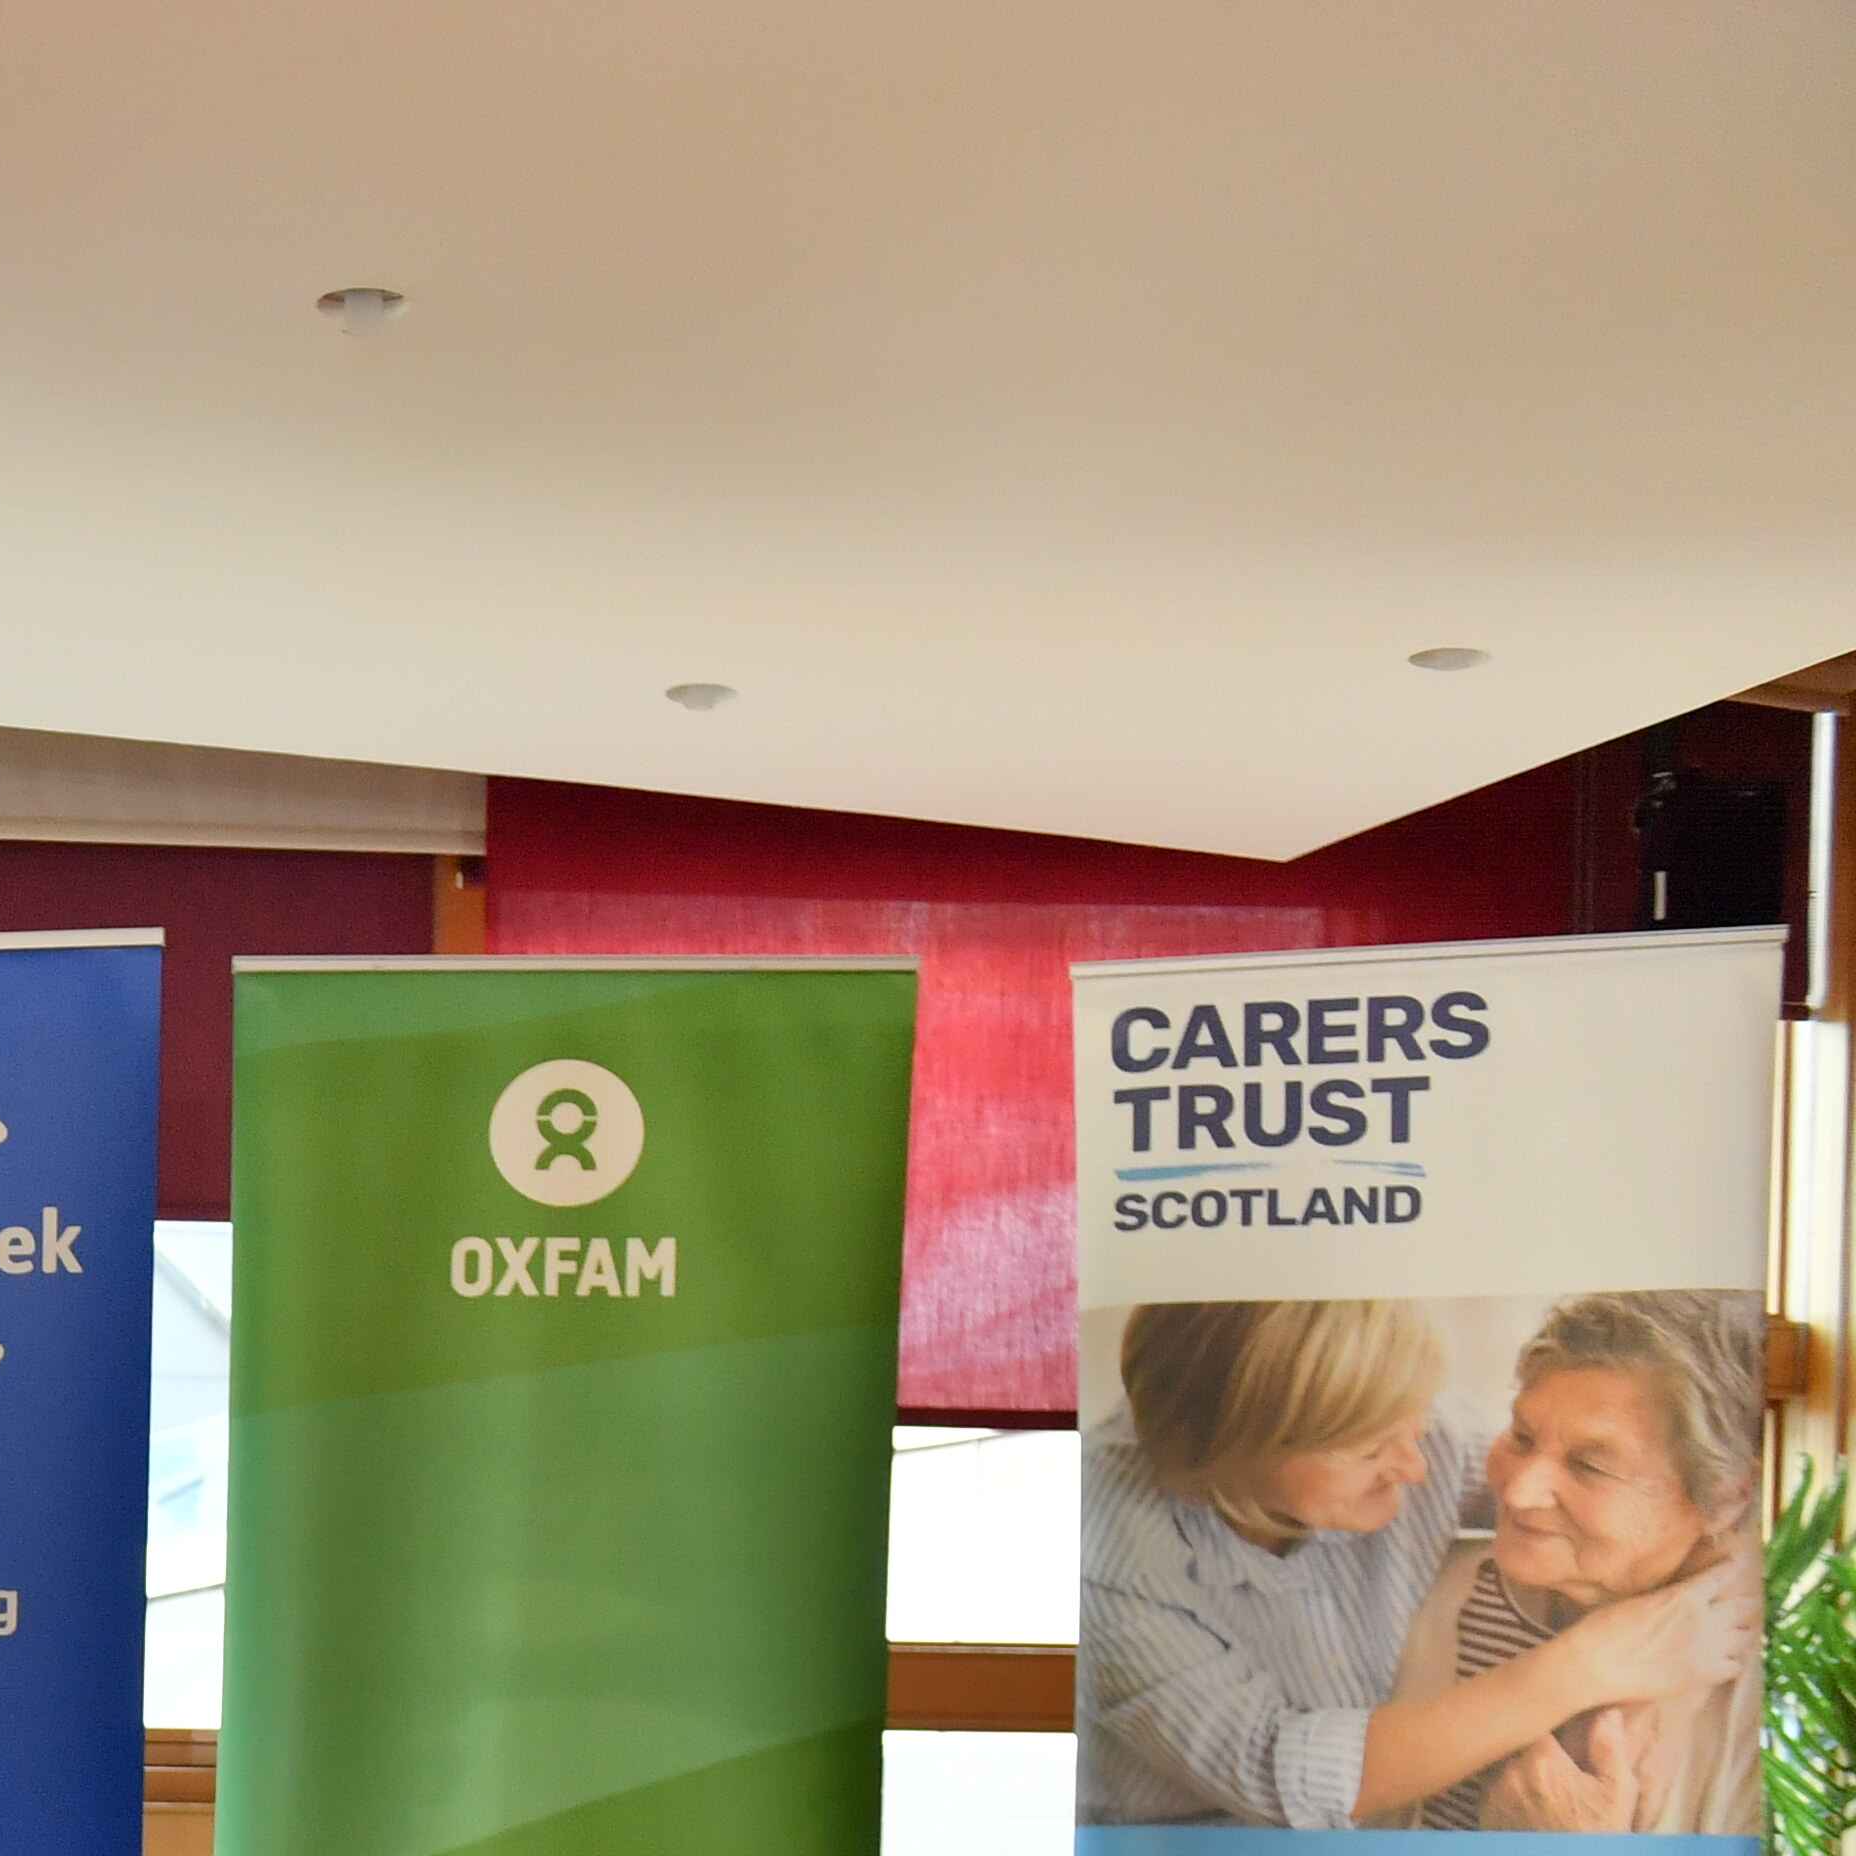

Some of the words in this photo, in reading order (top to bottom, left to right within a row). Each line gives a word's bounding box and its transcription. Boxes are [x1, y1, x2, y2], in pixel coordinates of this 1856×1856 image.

[1112, 992, 1489, 1073] CARERS
[1114, 1075, 1429, 1152] TRUST
[1115, 1186, 1421, 1231] SCOTLAND
[452, 1237, 676, 1297] OXFAM
